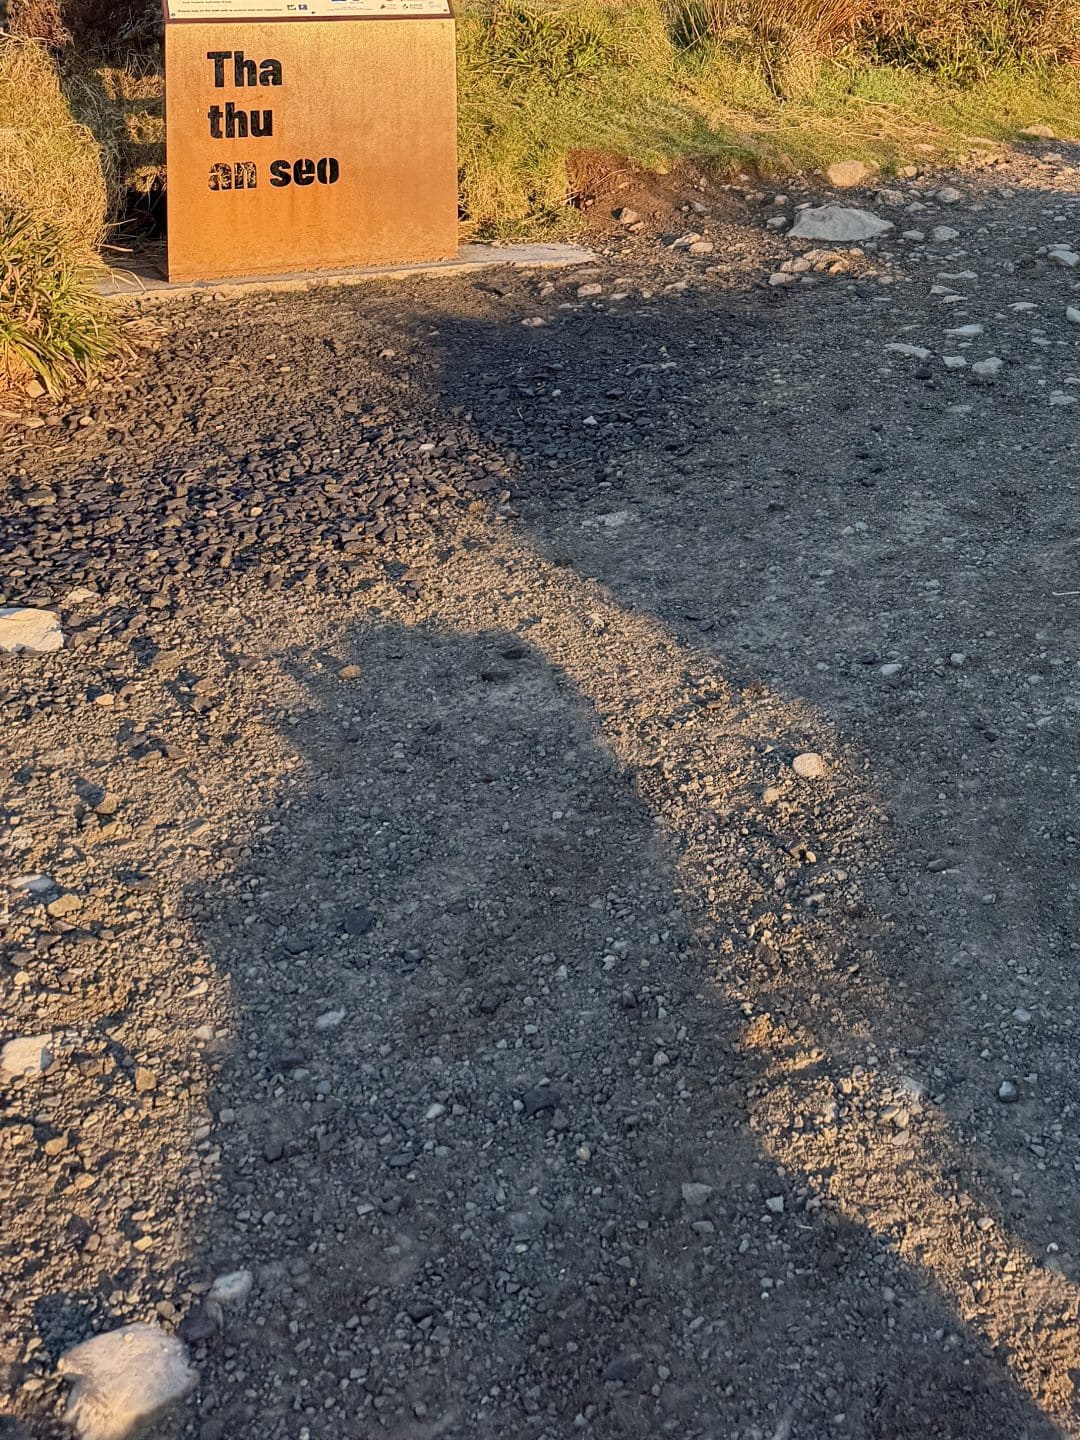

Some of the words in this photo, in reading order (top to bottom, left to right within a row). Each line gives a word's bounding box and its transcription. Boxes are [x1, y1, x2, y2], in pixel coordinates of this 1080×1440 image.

[206, 51, 283, 88] Tha
[207, 101, 273, 139] thu
[208, 161, 257, 192] an
[269, 157, 340, 188] seo
